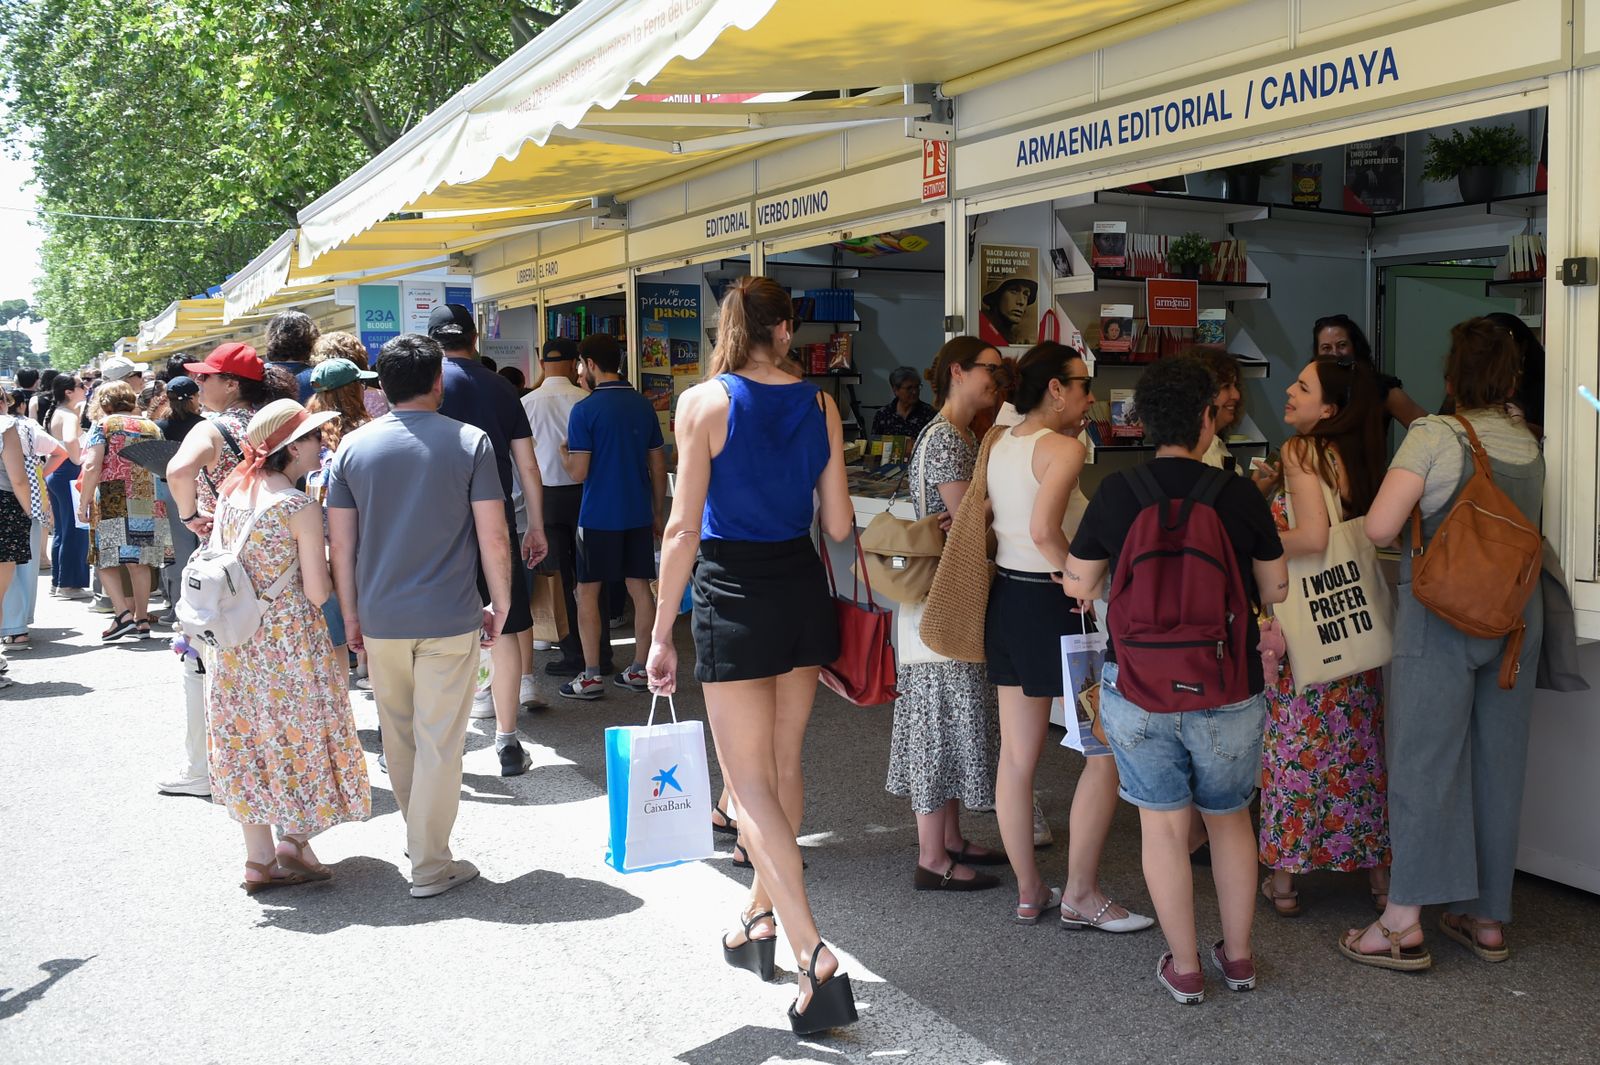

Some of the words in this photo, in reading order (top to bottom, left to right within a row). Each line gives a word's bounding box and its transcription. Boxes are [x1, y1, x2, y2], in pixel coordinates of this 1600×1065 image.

[633, 24, 642, 44] la
[644, 10, 666, 38] Feria
[1016, 119, 1113, 167] ARMAENIA
[1118, 90, 1232, 145] EDITORIAL
[1245, 80, 1254, 120] /
[1260, 46, 1399, 110] CANDAYA
[924, 181, 945, 196] EXTINTOR
[706, 210, 750, 239] EDITORIAL
[757, 200, 790, 227] VERBO
[791, 190, 829, 218] DIVINO
[986, 257, 1012, 265] VUESTRAS
[1004, 250, 1019, 258] ALGO
[1019, 251, 1031, 259] CON
[539, 264, 545, 279] EL
[545, 260, 559, 277] FARO
[986, 265, 993, 273] ES
[640, 293, 697, 311] primeros
[365, 309, 395, 322] 23A
[654, 307, 697, 320] pasos
[1302, 577, 1309, 598] I
[1310, 560, 1361, 595] WOULD
[1309, 586, 1367, 622] PREFER
[1317, 616, 1349, 646] NOT
[1348, 610, 1373, 634] TO
[643, 798, 692, 815] CaixaBank
